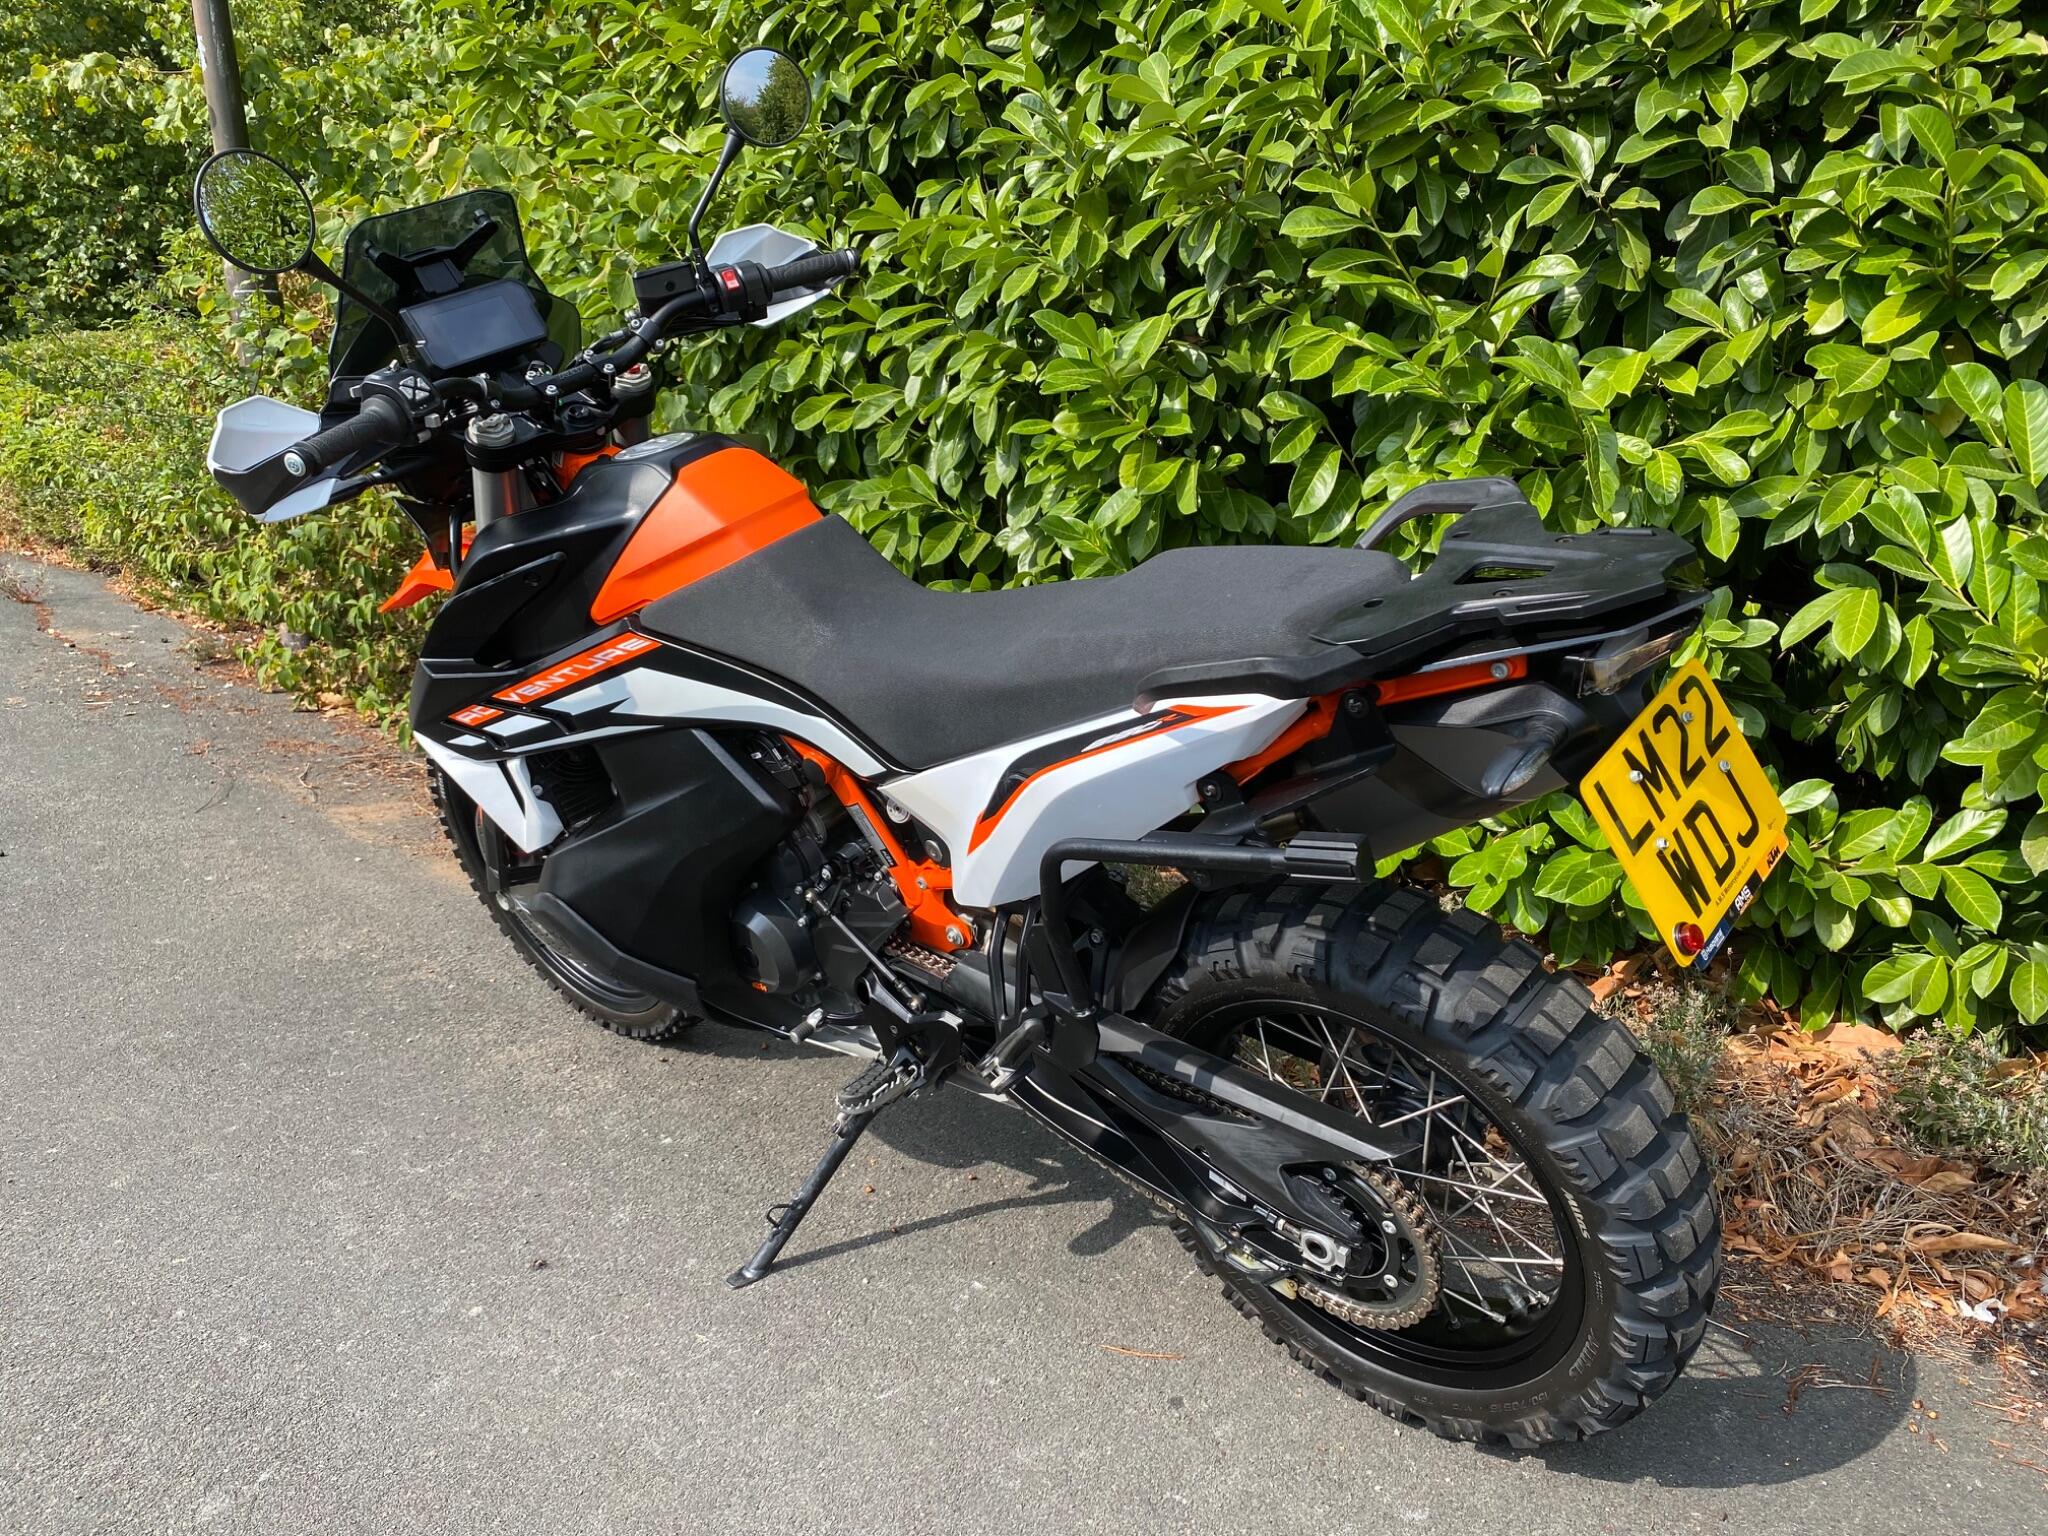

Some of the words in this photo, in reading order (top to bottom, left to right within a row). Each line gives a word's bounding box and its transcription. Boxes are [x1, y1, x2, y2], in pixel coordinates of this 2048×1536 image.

[1593, 674, 1731, 857] LM22
[1656, 768, 1760, 919] WDJ
[1766, 845, 1781, 869] KTM
[1734, 884, 1752, 912] AMS
